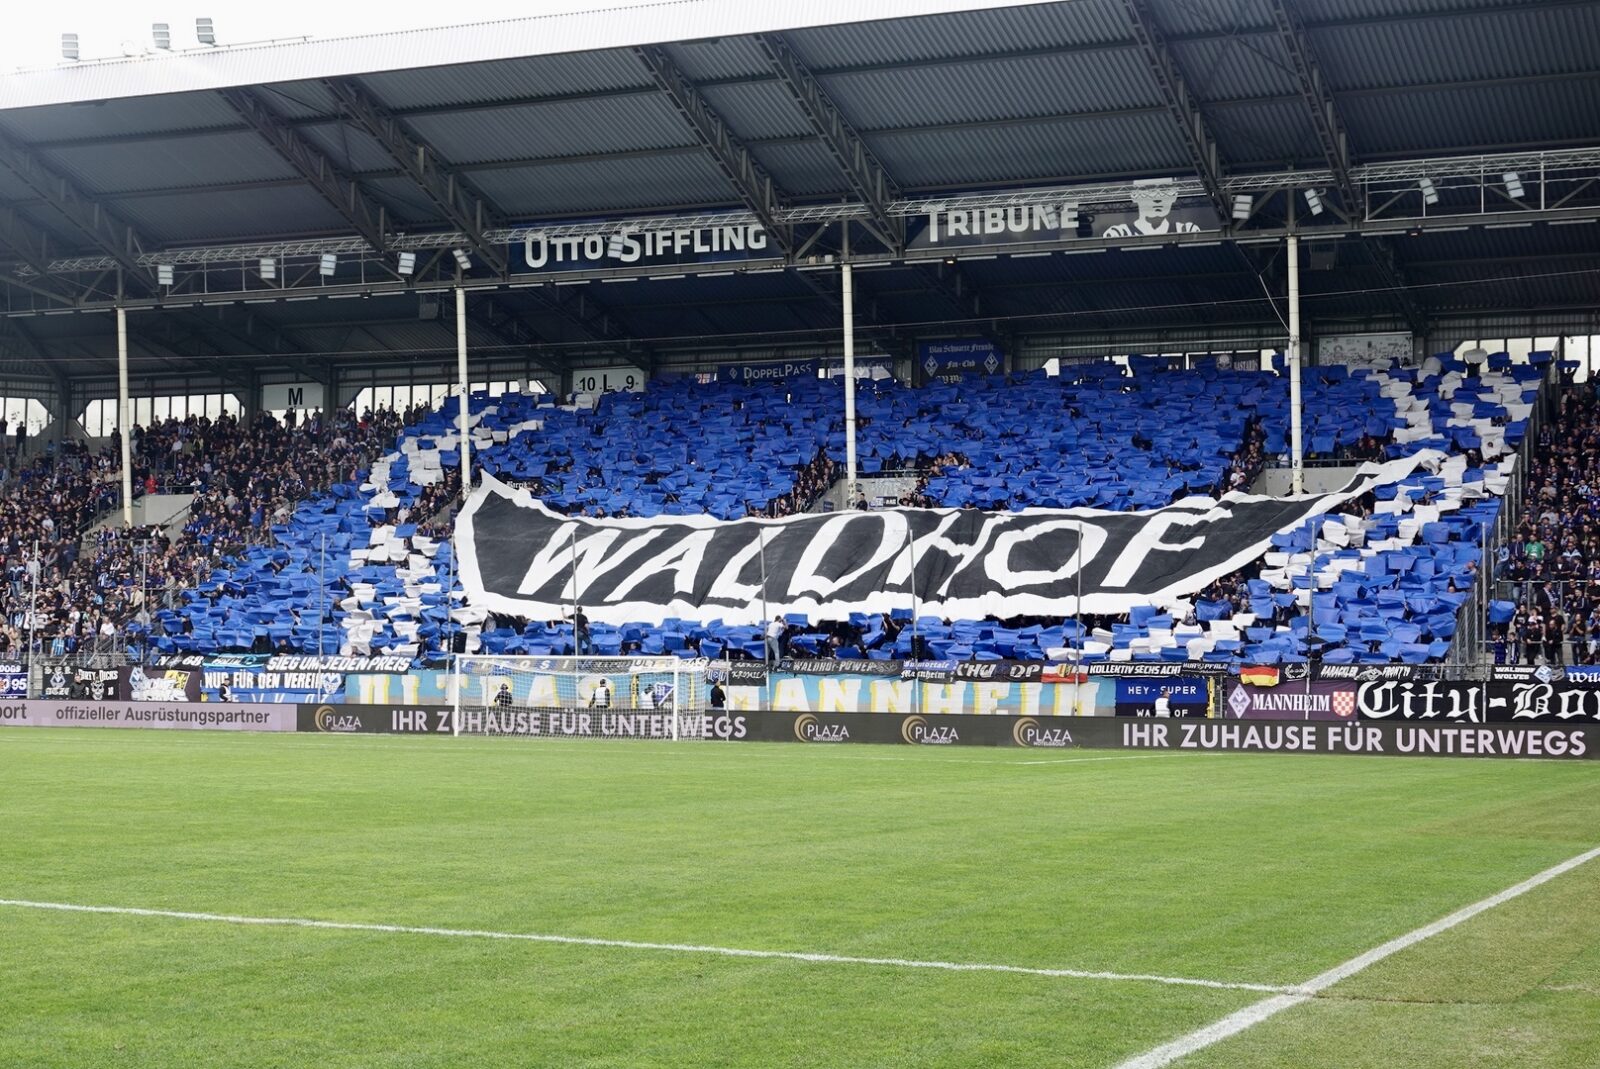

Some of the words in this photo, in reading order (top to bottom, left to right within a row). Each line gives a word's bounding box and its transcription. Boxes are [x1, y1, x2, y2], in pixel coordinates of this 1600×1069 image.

[525, 233, 604, 268] OTTO
[617, 225, 767, 263] SIFFLING
[579, 376, 596, 391] 10
[603, 374, 615, 392] L
[626, 375, 635, 389] 9
[288, 387, 303, 405] M
[516, 508, 1233, 602] WALDHOF
[267, 656, 299, 671] SIEG
[299, 656, 319, 671] UM
[320, 656, 366, 671] JEDEN
[366, 657, 411, 672] PREIS
[1089, 663, 1133, 674] KOLLEKTIV
[1134, 664, 1160, 674] SECHS
[1159, 664, 1181, 675] ACHT
[11, 678, 27, 691] 95
[233, 669, 255, 689] FÜR
[258, 672, 281, 689] DEN
[1252, 693, 1331, 712] MANNHEIM
[56, 705, 120, 720] offizieller
[124, 707, 270, 725] Ausrüstungspartner
[325, 715, 362, 728] PLAZA
[1136, 709, 1189, 717] WAOF
[392, 710, 428, 731] IHR
[436, 710, 541, 735] ZUHAUSE
[550, 709, 592, 736] FÜR
[601, 714, 747, 739] UNTERWEGS
[807, 724, 850, 739] PLAZA
[915, 727, 959, 741] PLAZA
[1027, 728, 1072, 743] PLAZA
[1123, 723, 1169, 747] IHR
[1180, 724, 1316, 750] ZUHAUSE
[1327, 721, 1384, 751] FÜR
[1396, 728, 1586, 756] UNTERWEGS
